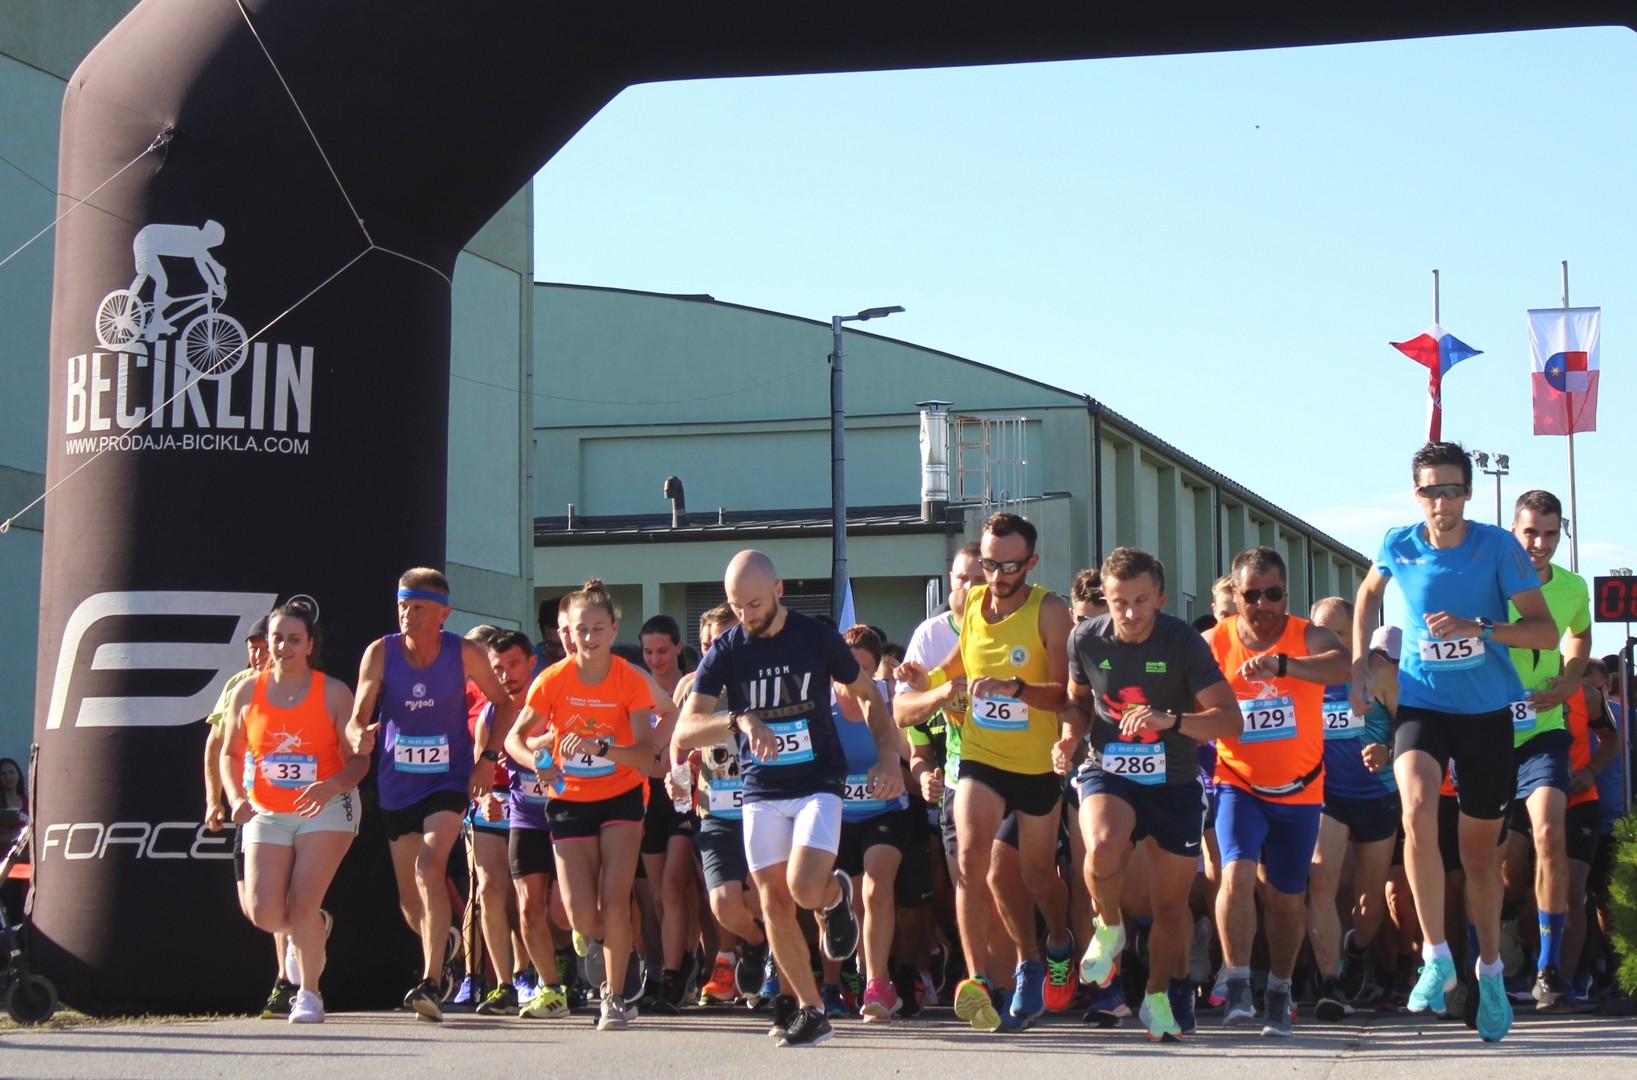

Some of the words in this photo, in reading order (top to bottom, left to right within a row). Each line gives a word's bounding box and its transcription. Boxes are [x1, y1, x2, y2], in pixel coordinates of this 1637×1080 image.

[66, 339, 314, 434] BECIKLIN
[66, 434, 309, 455] WWW.PRODAJA-BICIKLA.COM
[1430, 639, 1472, 659] 125
[759, 665, 790, 678] FROM
[985, 701, 1011, 720] 26
[1247, 709, 1285, 729] 129
[1327, 712, 1349, 728] 25
[405, 747, 440, 763] 112
[277, 764, 301, 779] 33
[1114, 756, 1155, 774] 286
[42, 821, 236, 861] FORCE
